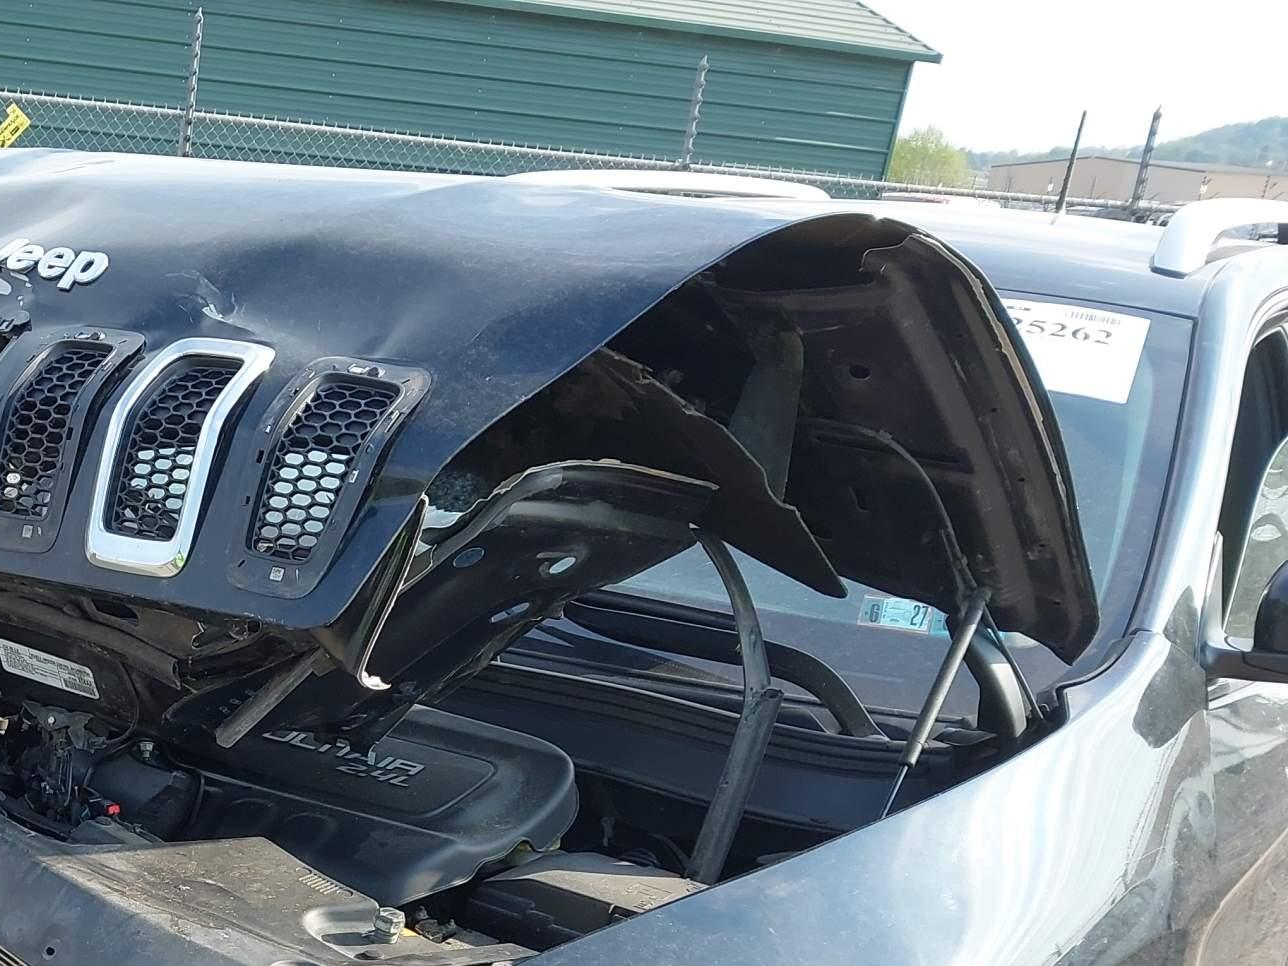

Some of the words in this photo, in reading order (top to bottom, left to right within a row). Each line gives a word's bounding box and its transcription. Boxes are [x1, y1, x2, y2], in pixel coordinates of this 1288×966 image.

[1013, 316, 1113, 345] 5262
[869, 603, 881, 623] 6
[909, 604, 929, 628] 27
[336, 762, 409, 787] 2.4L
